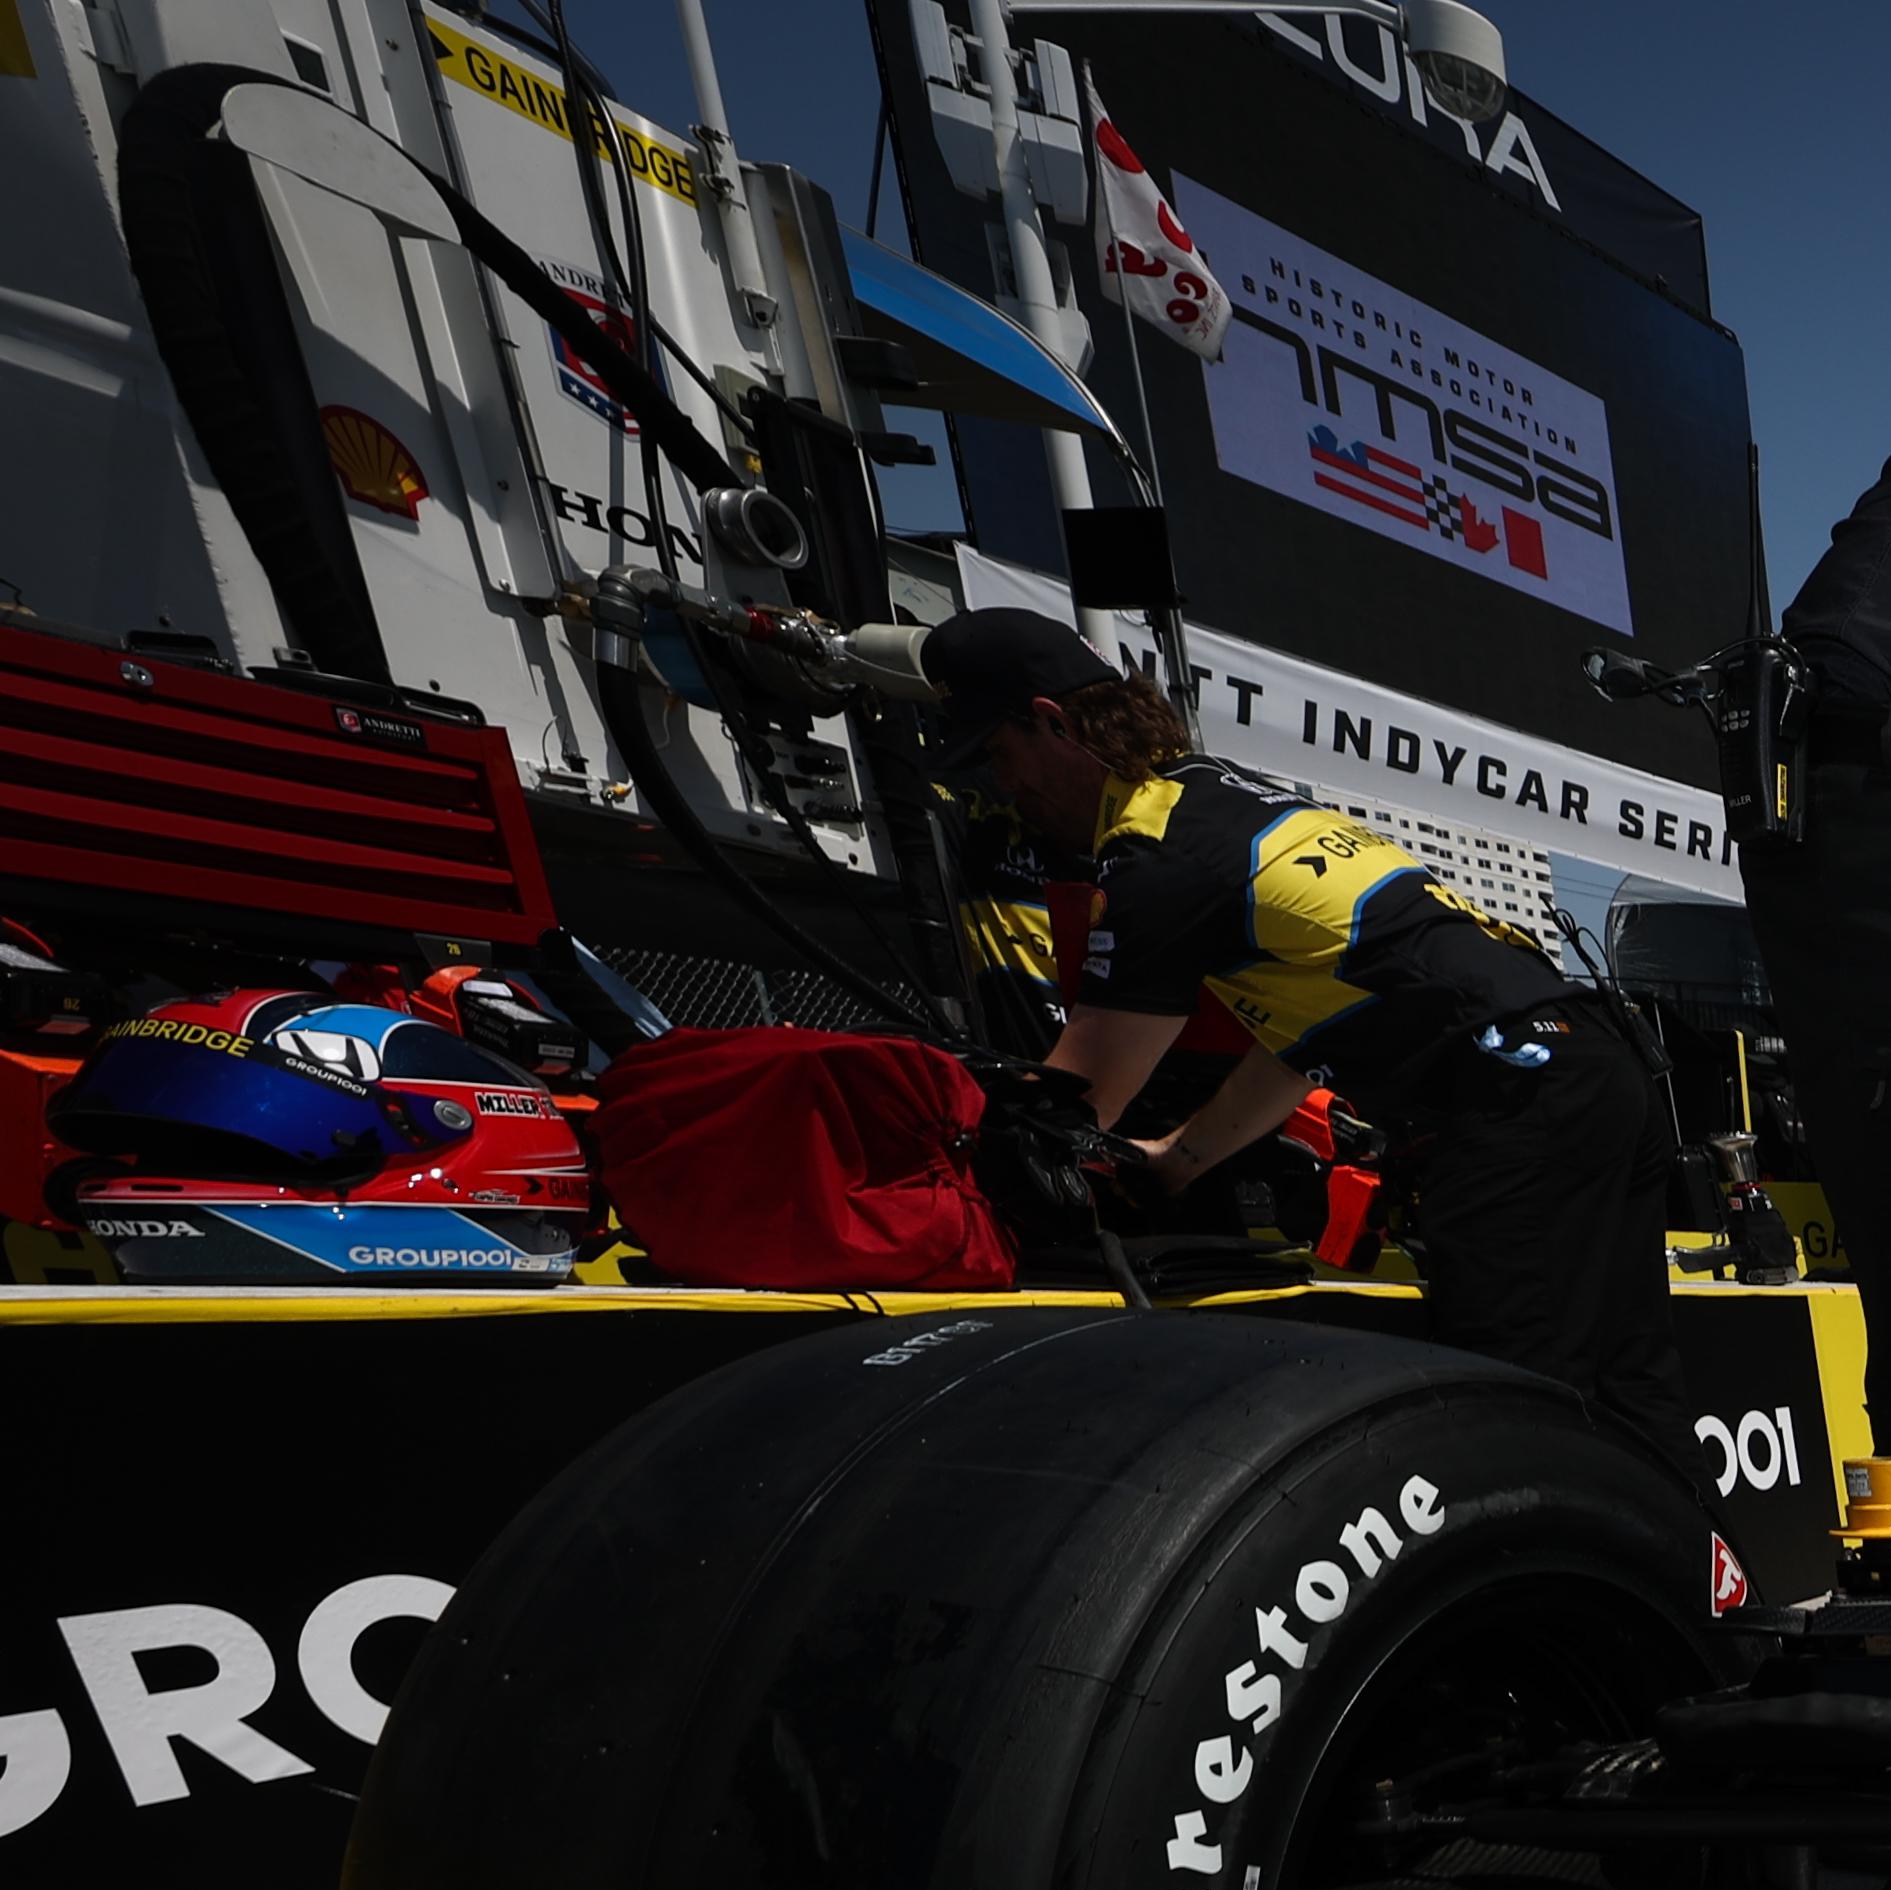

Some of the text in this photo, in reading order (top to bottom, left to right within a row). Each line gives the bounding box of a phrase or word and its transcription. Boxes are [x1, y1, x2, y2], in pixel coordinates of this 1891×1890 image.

[1242, 274, 1577, 455] SPORTS ASSOCIATION
[1270, 256, 1423, 349] HISTORIC
[1444, 345, 1534, 407] MOTOR
[551, 483, 703, 566] HON
[1302, 700, 1589, 825] INDYCAR
[1618, 797, 1732, 867] SERI
[285, 1056, 366, 1097] GROUP1001
[349, 1246, 511, 1267] GROUP1001
